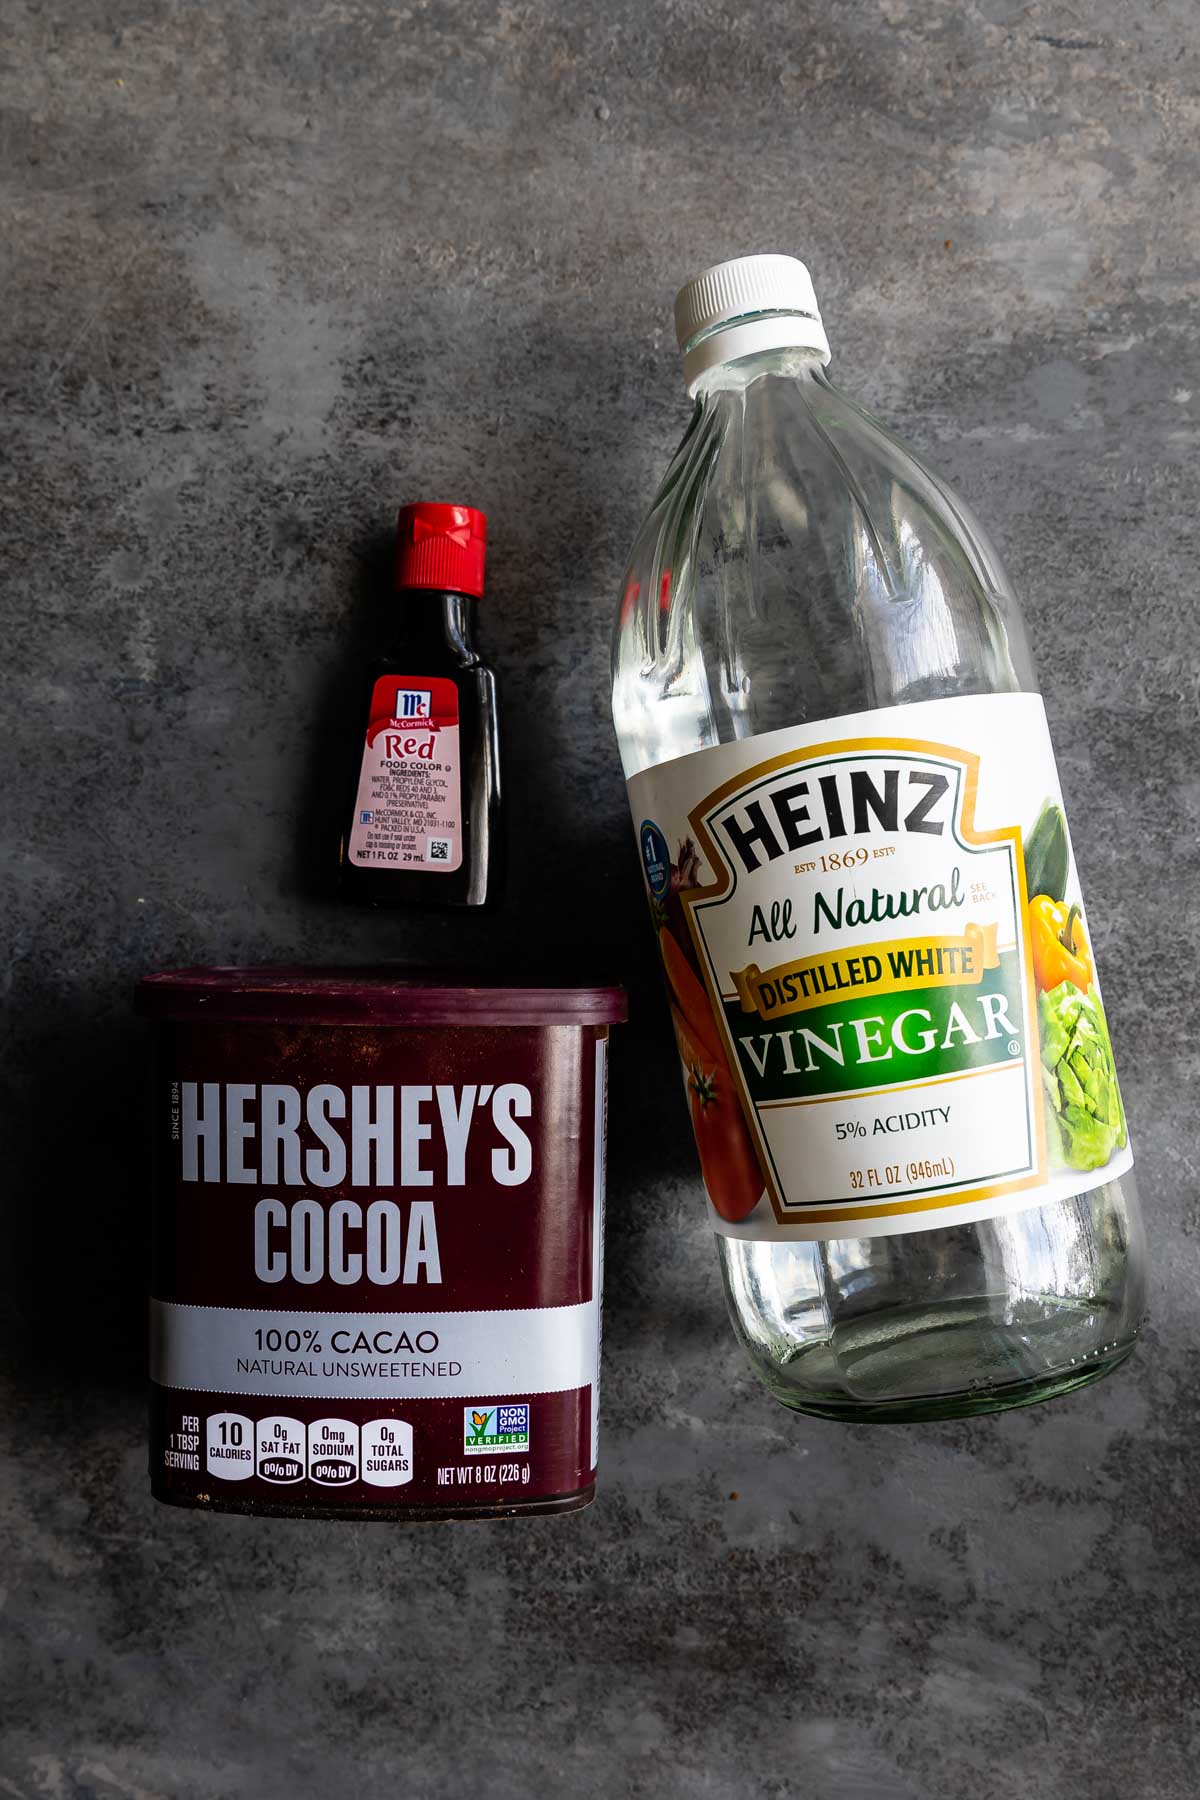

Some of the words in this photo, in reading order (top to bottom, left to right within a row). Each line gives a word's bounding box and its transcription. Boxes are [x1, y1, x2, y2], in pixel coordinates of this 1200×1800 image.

[390, 718, 434, 728] McCormick
[385, 734, 436, 760] Red
[380, 761, 408, 769] FOOD
[410, 762, 442, 771] COLOR
[390, 769, 431, 778] INGREDIENTS:
[392, 777, 424, 786] PROPYLENE
[396, 784, 410, 792] REDS
[420, 786, 432, 794] AND
[371, 791, 384, 799] AND
[399, 792, 446, 802] PROPYLPARABEN
[376, 809, 408, 818] McCORMICK
[381, 824, 401, 832] PACKED
[720, 769, 950, 874] HEINZ
[357, 850, 370, 859] NET
[372, 851, 376, 859] 1
[377, 852, 386, 860] FL
[388, 852, 398, 860] OZ
[403, 853, 412, 861] 29
[413, 854, 425, 862] mL
[818, 847, 869, 873] 1869
[970, 882, 988, 894] SEE
[747, 898, 798, 947] All
[812, 866, 966, 935] Natural
[758, 955, 882, 1011] DISTILLED
[886, 946, 974, 978] WHITE
[738, 993, 1020, 1078] VINEGAR
[171, 1082, 180, 1104] 1894
[171, 1107, 180, 1140] SINCE
[835, 1120, 867, 1140] 5%
[872, 1106, 952, 1135] ACIDITY
[182, 1081, 532, 1188] HERSHEY'S
[849, 1171, 865, 1190] 32
[867, 1168, 882, 1187] FL
[884, 1166, 902, 1184] OZ
[906, 1158, 956, 1182] (946mL)
[254, 1198, 442, 1286] COCOA
[254, 1328, 323, 1354] 100%
[330, 1330, 440, 1354] CACAO
[236, 1358, 318, 1377] NATURAL
[322, 1361, 462, 1379] UNSWEETENED
[500, 1408, 526, 1417] NON
[182, 1416, 200, 1432] PER
[500, 1416, 526, 1426] GMO
[218, 1421, 243, 1446] 10
[274, 1424, 288, 1441] 0g
[322, 1426, 345, 1442] 0mg
[380, 1427, 395, 1443] 0g
[500, 1426, 525, 1434] Project
[170, 1434, 174, 1448] 1
[177, 1434, 200, 1452] TBSP
[469, 1435, 526, 1445] VERIFIED
[210, 1447, 252, 1460] CALORIES
[261, 1441, 280, 1453] SAT
[282, 1442, 301, 1454] FAT
[312, 1444, 354, 1456] SODIUM
[371, 1445, 404, 1456] TOTAL
[465, 1444, 528, 1453] nongmoproject.org
[164, 1450, 200, 1471] SERVING
[366, 1460, 409, 1471] SUGARS
[264, 1463, 285, 1476] 0%
[285, 1464, 298, 1476] DV
[316, 1465, 337, 1478] 0%
[338, 1466, 352, 1478] DV
[437, 1468, 455, 1485] NET
[457, 1467, 473, 1484] WT
[475, 1466, 481, 1483] 8
[484, 1465, 496, 1483] OZ
[499, 1464, 519, 1485] (226
[522, 1462, 530, 1484] g)
